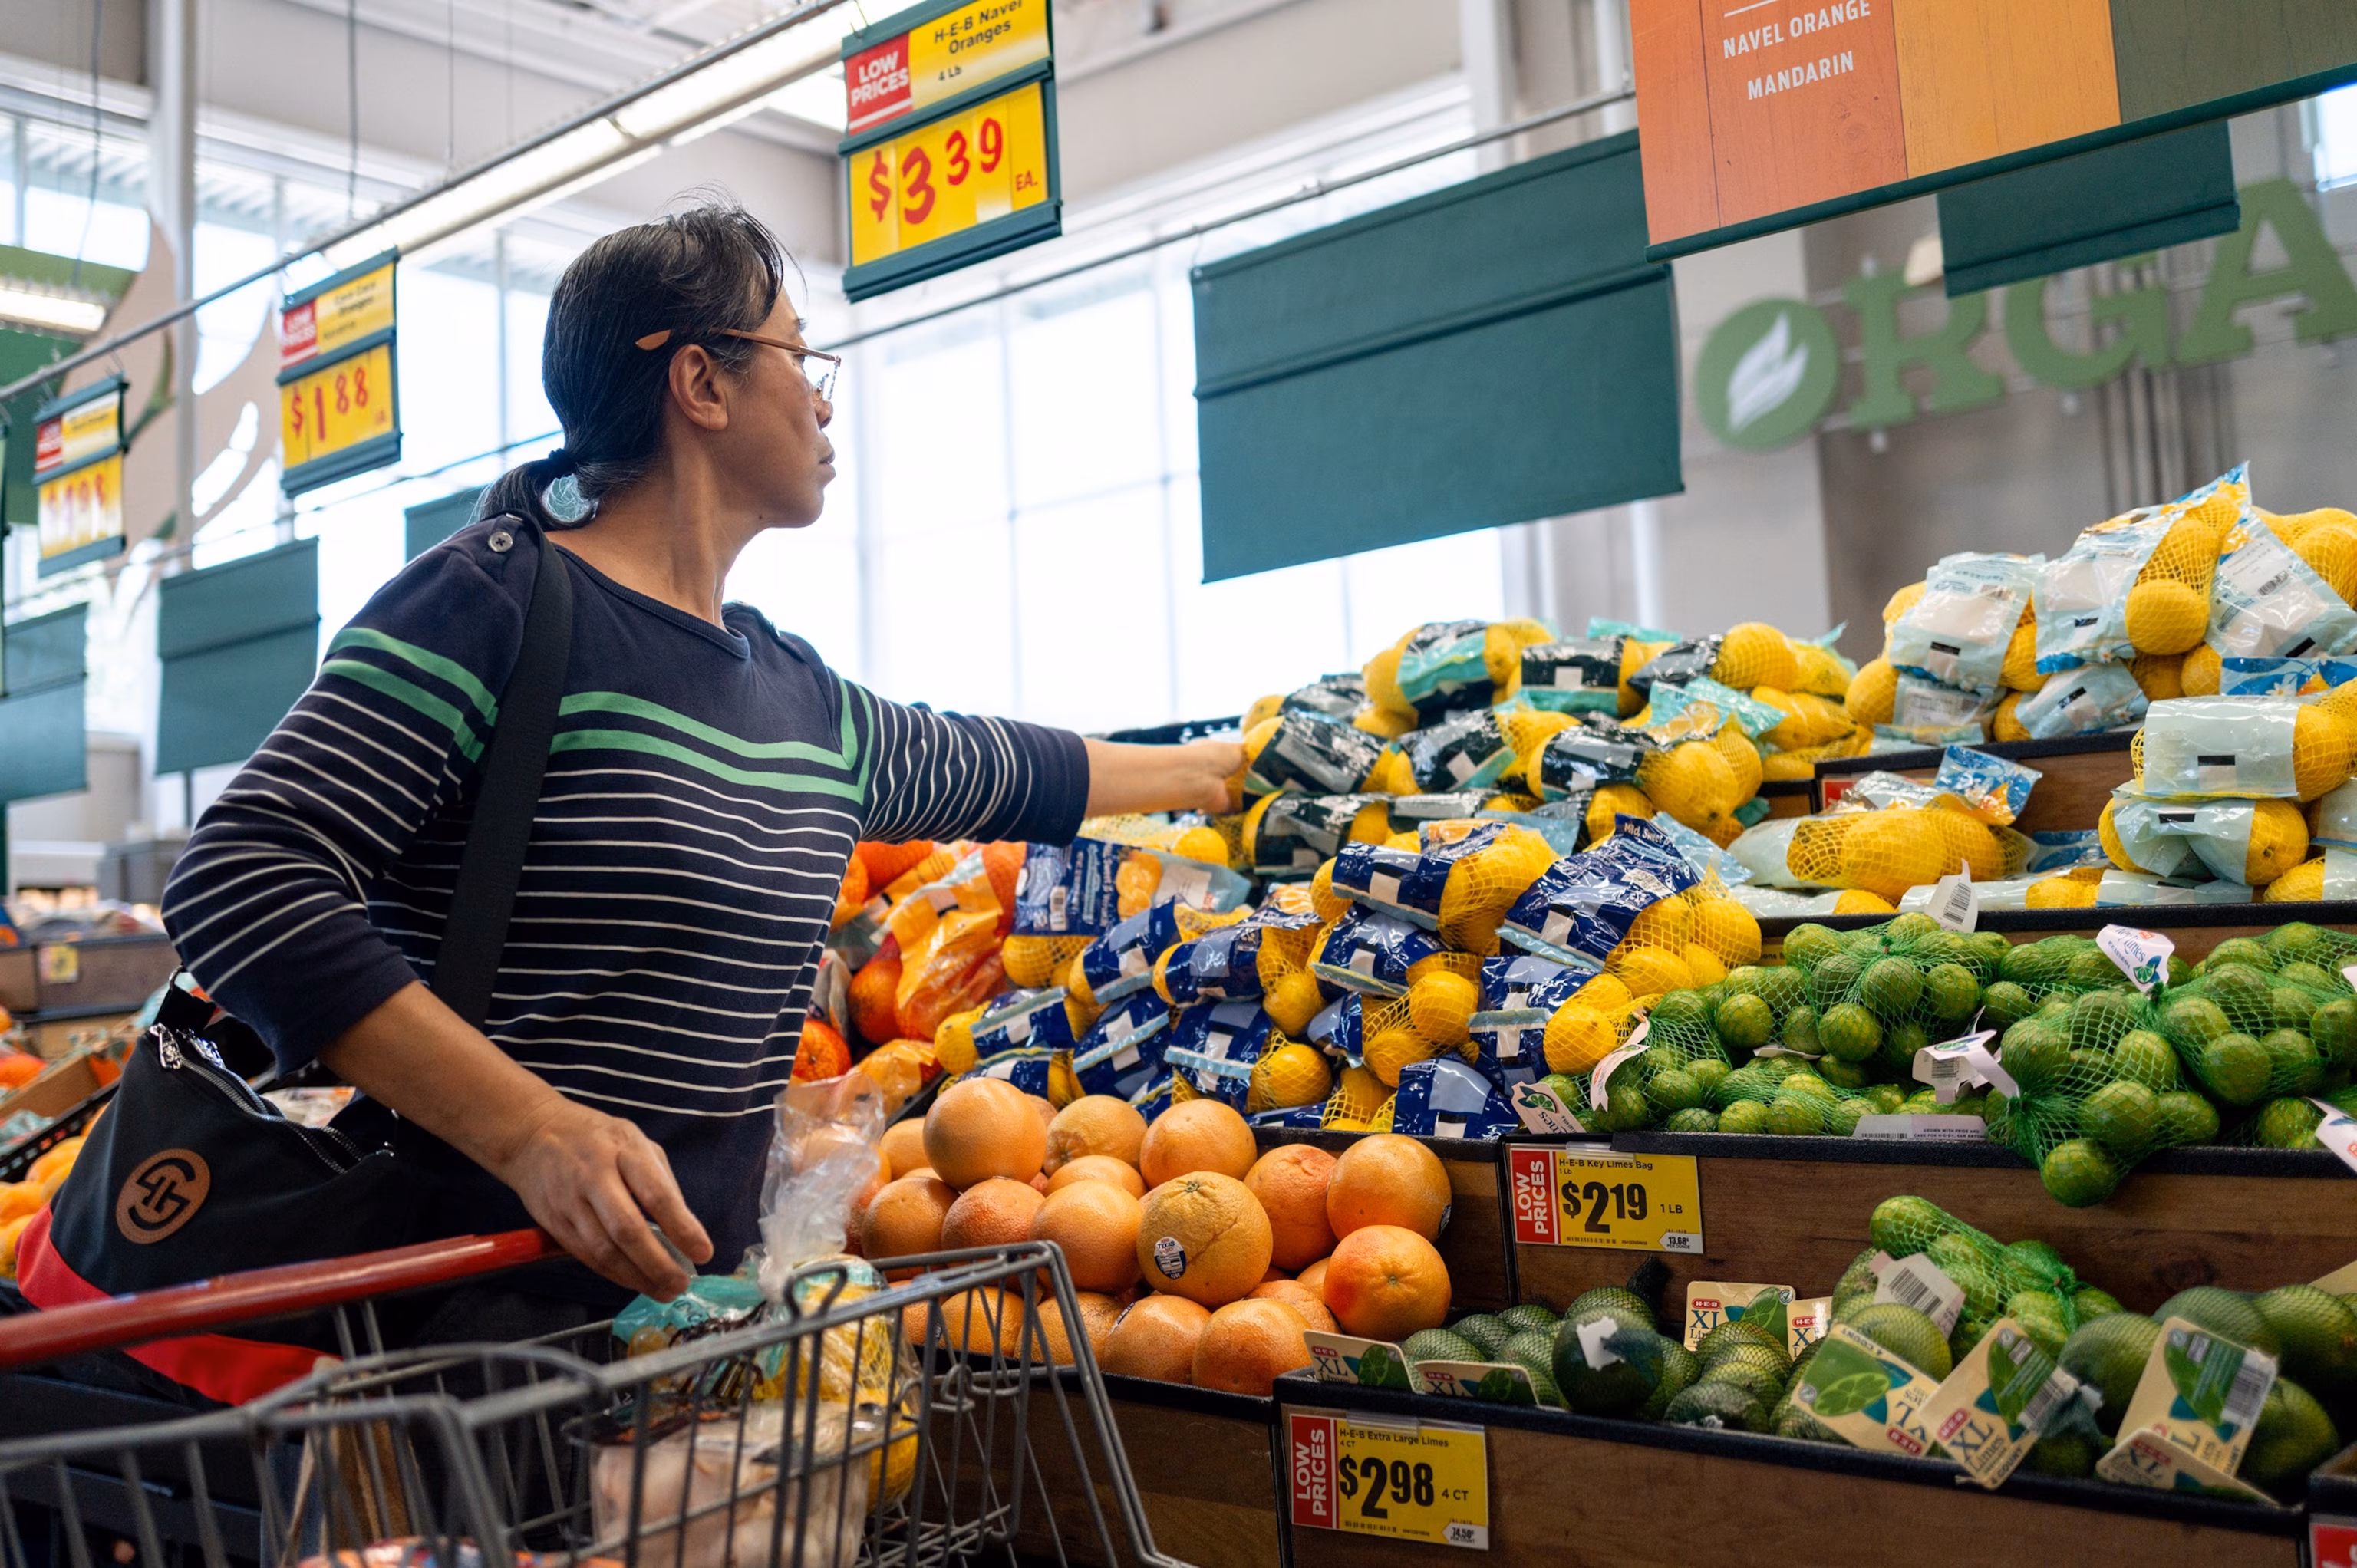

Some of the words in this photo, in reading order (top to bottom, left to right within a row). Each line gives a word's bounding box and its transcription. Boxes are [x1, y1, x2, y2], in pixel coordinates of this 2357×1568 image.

[934, 16, 974, 44] H-E-B
[948, 19, 1012, 54] Oranges
[1722, 24, 1785, 59] NAVEL
[1790, 0, 1871, 39] ORANGE
[858, 51, 899, 84] LOW
[938, 71, 945, 81] 4
[1747, 51, 1854, 100] MANDARIN
[851, 68, 911, 107] PRICES
[1015, 170, 1038, 191] EA.
[1559, 1158, 1584, 1167] H-E-B
[1587, 1159, 1604, 1169] Key
[1607, 1160, 1633, 1169] Limes
[1635, 1161, 1653, 1171] Bag
[1516, 1173, 1532, 1221] LOW
[1531, 1160, 1548, 1234] PRICES
[1660, 1204, 1665, 1213] 1
[1669, 1204, 1683, 1214] LB
[1314, 1356, 1348, 1377] XL
[1340, 1429, 1365, 1439] H-E-B
[1368, 1431, 1391, 1441] Extra
[1393, 1434, 1419, 1445] Large
[1422, 1436, 1449, 1448] Limes
[1949, 1420, 1994, 1463] XL
[1296, 1442, 1310, 1500] LOW
[1310, 1428, 1327, 1516] PRICES
[1442, 1488, 1449, 1499] 4
[1452, 1489, 1469, 1501] CT
